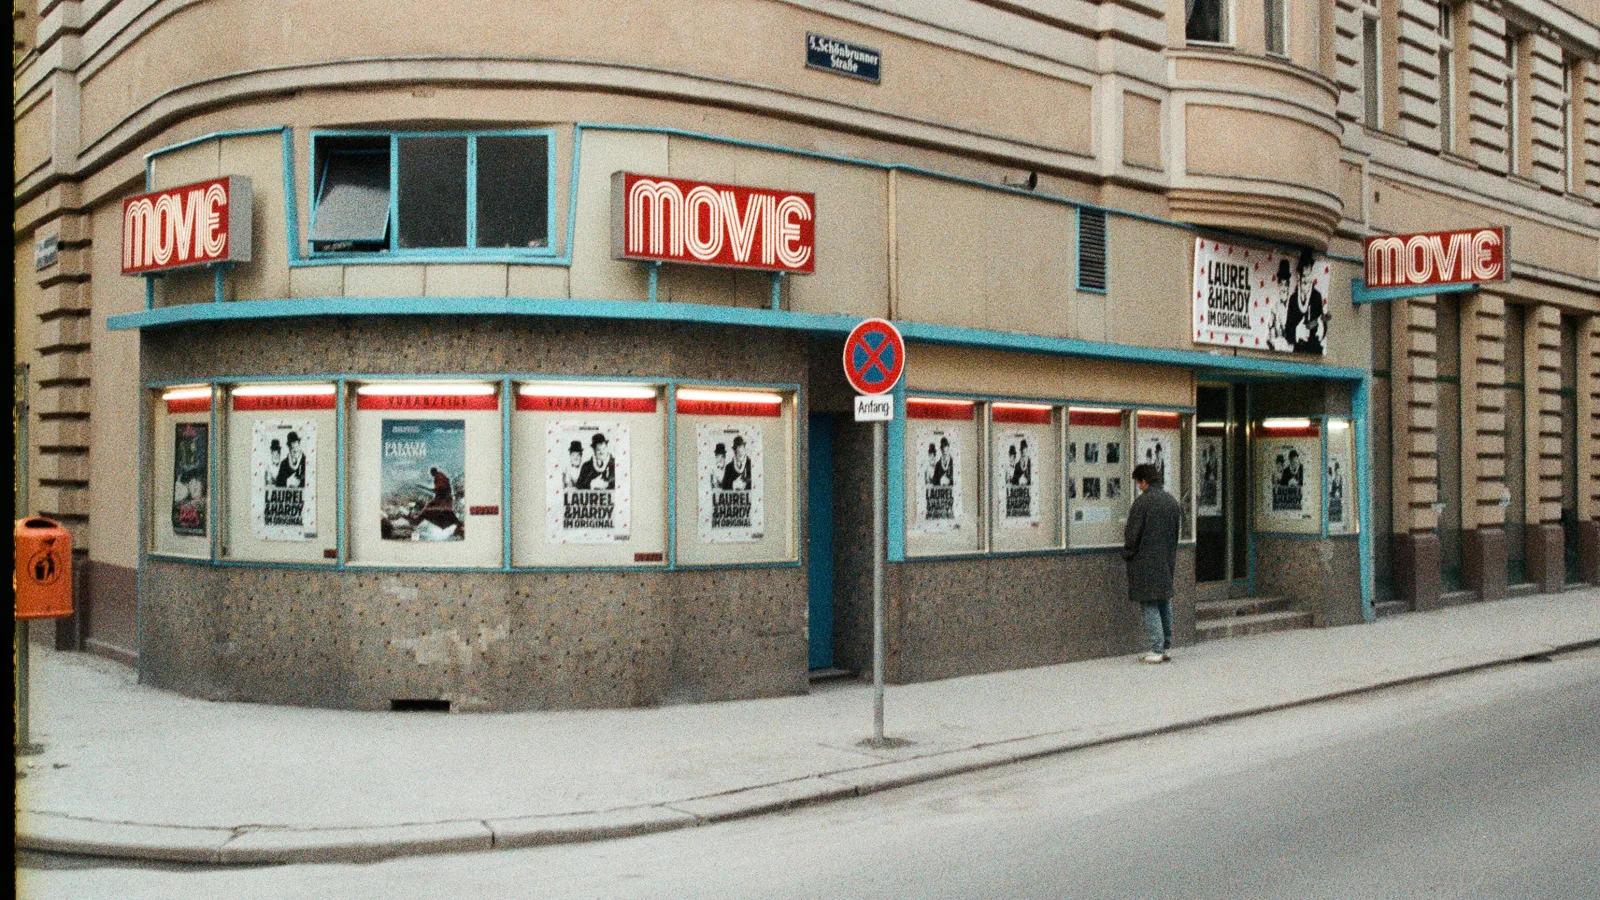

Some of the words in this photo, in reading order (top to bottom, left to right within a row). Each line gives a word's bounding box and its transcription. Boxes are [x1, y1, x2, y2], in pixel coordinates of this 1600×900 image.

[831, 53, 858, 73] Straße
[123, 183, 227, 269] MOVIE
[629, 179, 812, 268] MOVIE
[1367, 230, 1501, 285] MOVIE
[1208, 261, 1251, 290] LAUREL
[1207, 309, 1216, 326] IM
[1217, 311, 1252, 330] ORIGINAL
[858, 400, 889, 416] Anfang
[265, 490, 304, 503] LAUREL
[564, 492, 614, 506] LAUREL
[712, 492, 751, 506] LAUREL
[574, 519, 615, 529] ORIGINAL
